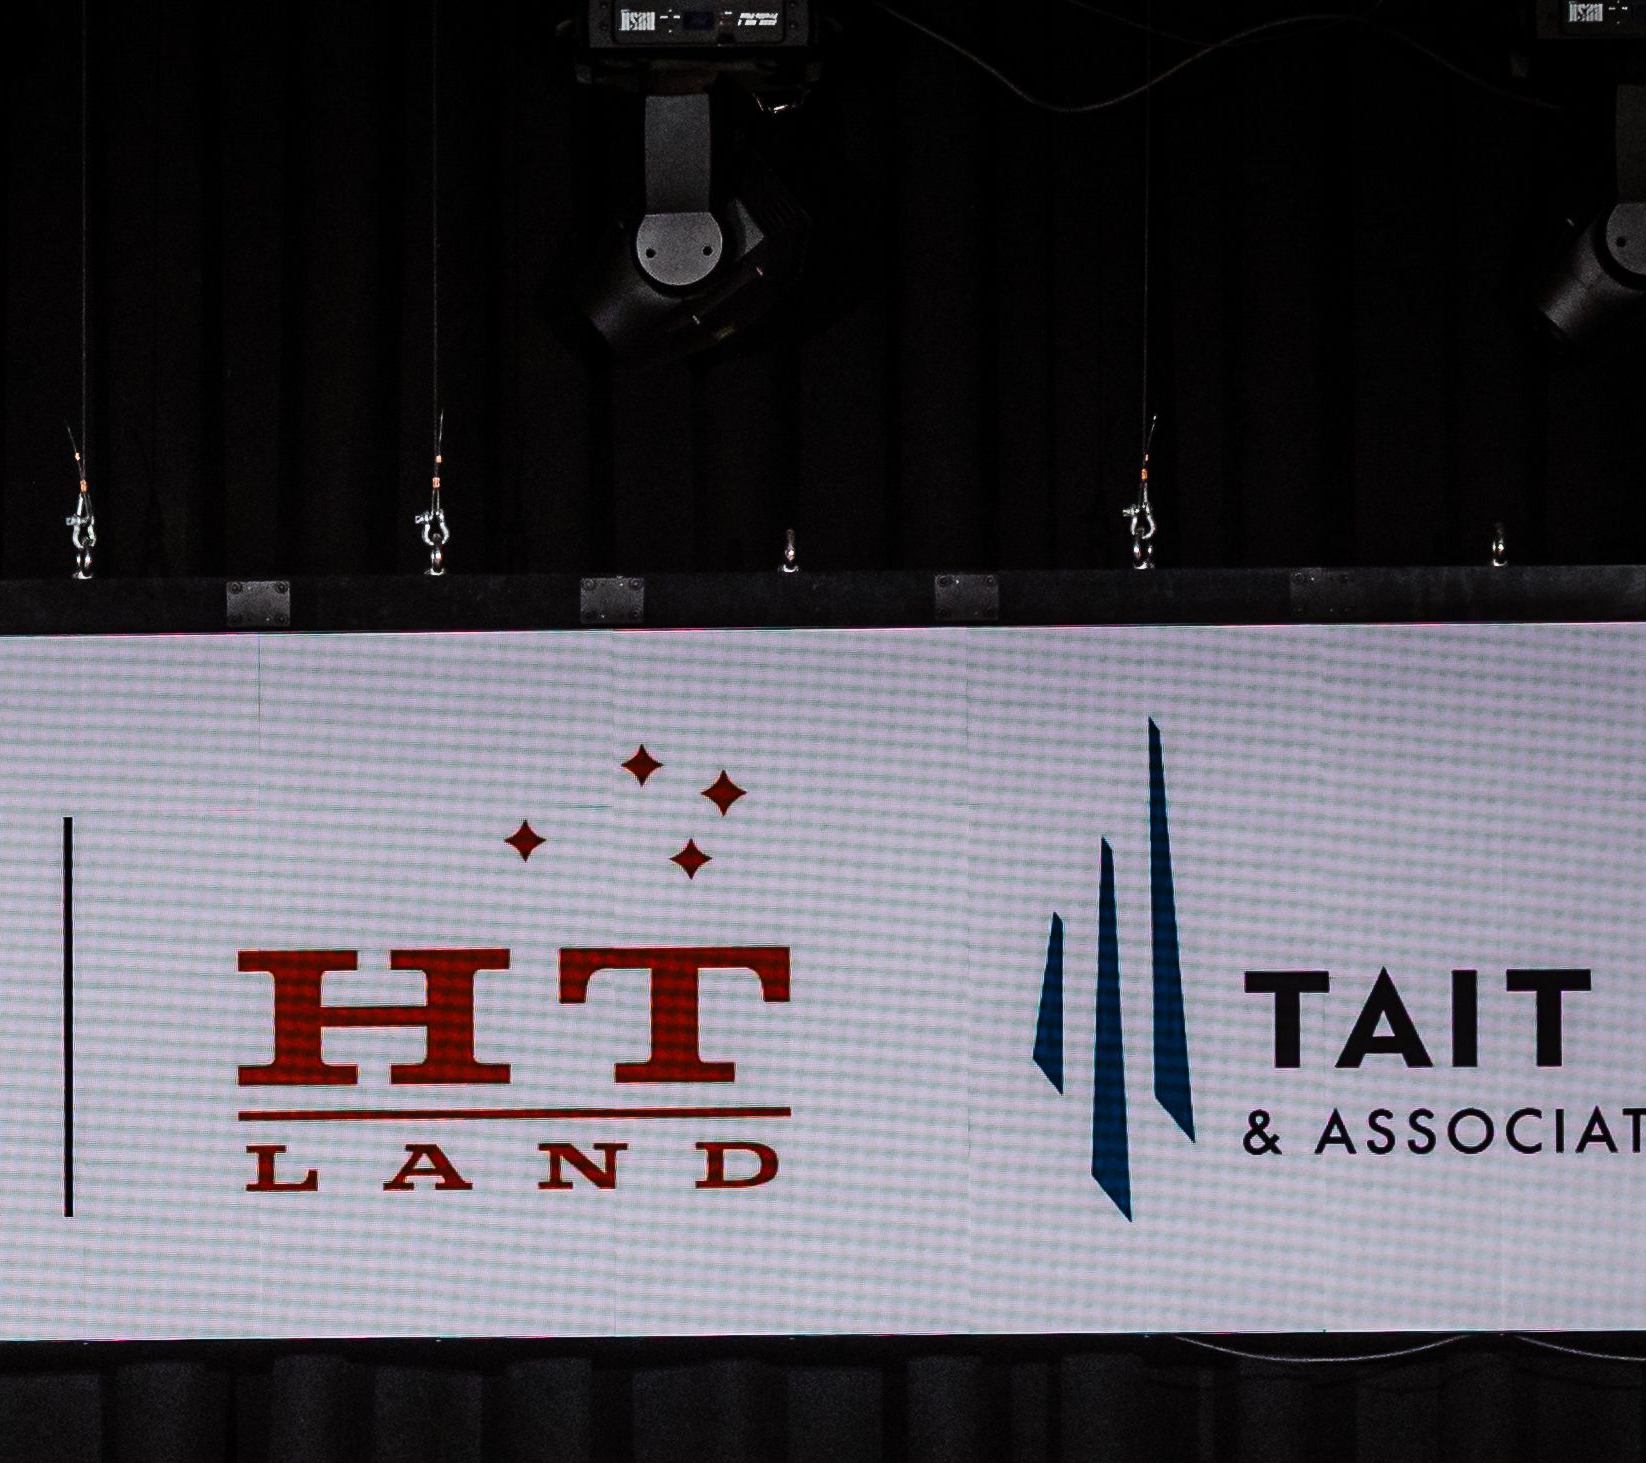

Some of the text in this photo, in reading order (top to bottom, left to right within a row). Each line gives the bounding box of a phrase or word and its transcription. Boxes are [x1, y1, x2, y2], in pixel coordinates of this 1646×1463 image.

[237, 945, 791, 1087] HT
[1244, 966, 1592, 1069] TAIT
[245, 1141, 779, 1193] LAND
[1242, 1109, 1283, 1156] &
